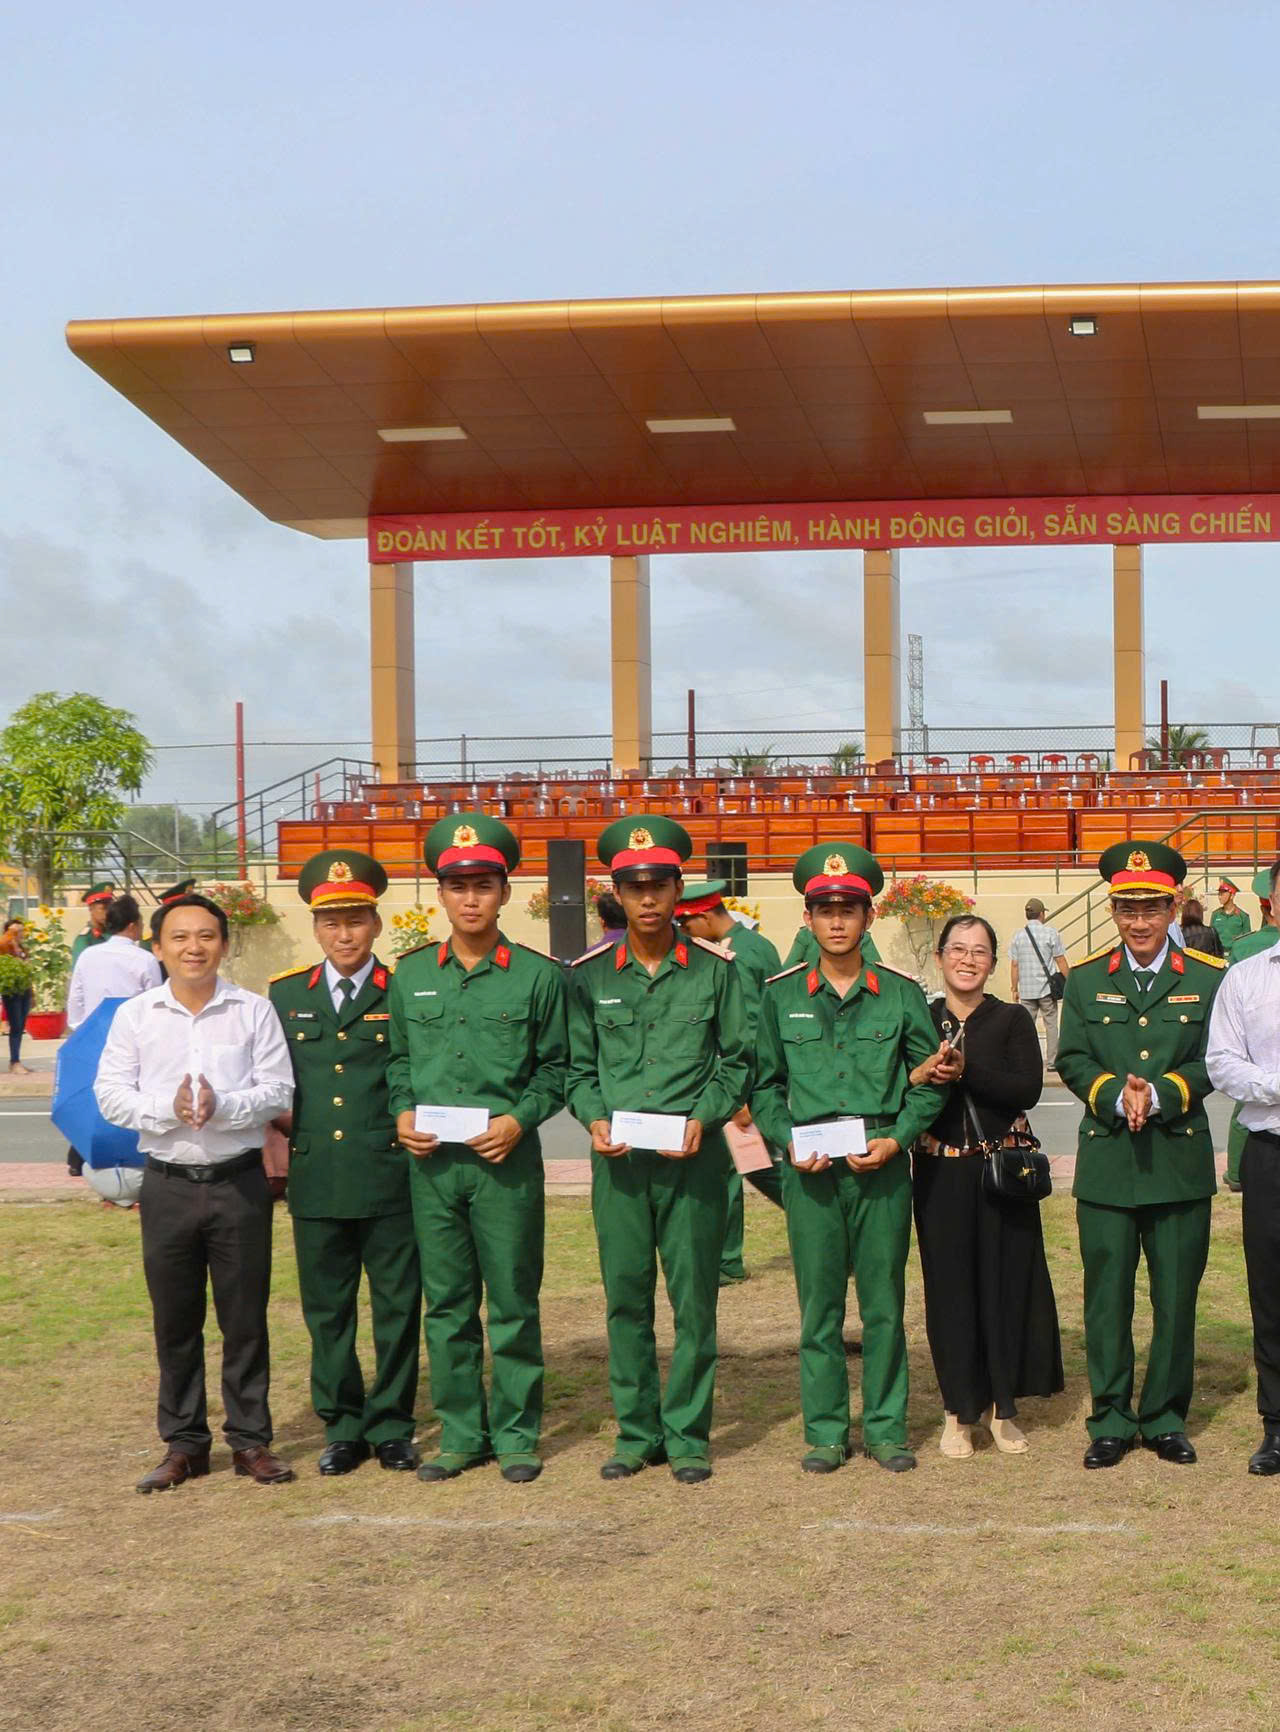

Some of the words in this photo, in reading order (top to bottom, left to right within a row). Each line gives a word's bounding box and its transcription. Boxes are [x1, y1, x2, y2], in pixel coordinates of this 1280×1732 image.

[376, 520, 447, 552] ĐOÀN
[456, 520, 504, 550] KẾT
[512, 518, 565, 551] TỐT,
[575, 517, 608, 546] KỶ
[617, 518, 680, 549] LUẬT
[690, 515, 799, 545] NGHIÊM,
[808, 513, 880, 541] HÀNH
[889, 511, 965, 544] ĐỘNG
[974, 507, 1036, 541] GIỎI,
[1044, 503, 1098, 537] SẴN
[1106, 508, 1180, 536] SÀNG
[1189, 503, 1272, 534] CHIẾN
